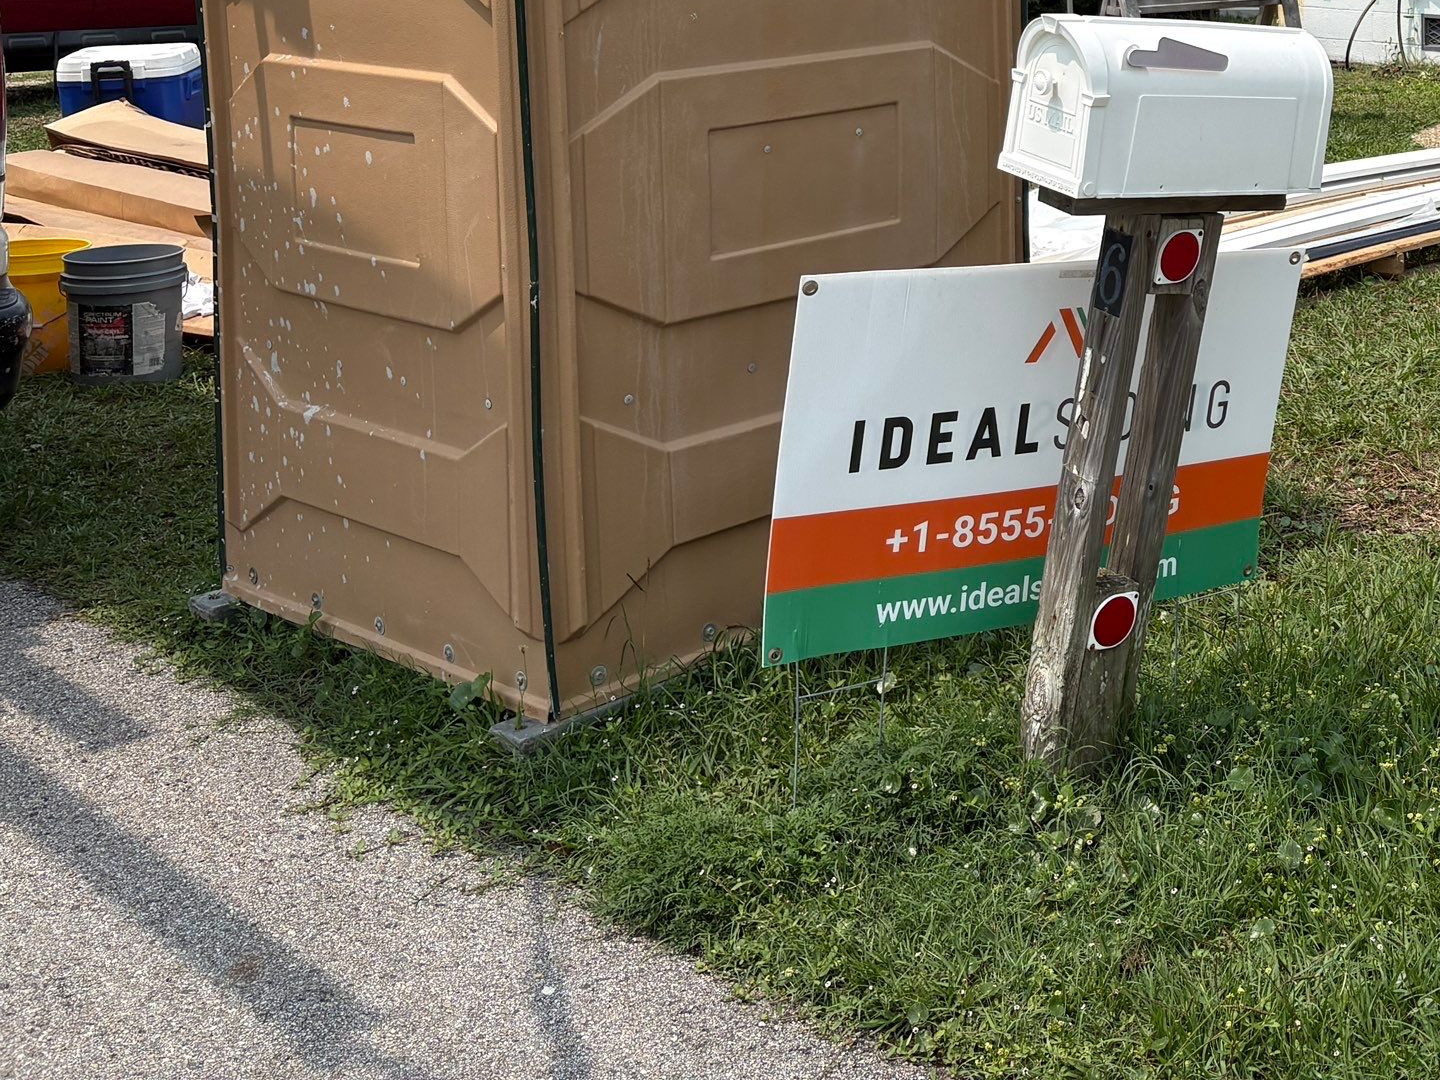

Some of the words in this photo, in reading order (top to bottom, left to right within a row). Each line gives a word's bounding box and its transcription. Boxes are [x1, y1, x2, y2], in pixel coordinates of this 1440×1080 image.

[1027, 104, 1044, 123] US
[1044, 109, 1074, 135] MAIL
[1100, 242, 1126, 305] 6
[848, 380, 1231, 474] IDEALSG
